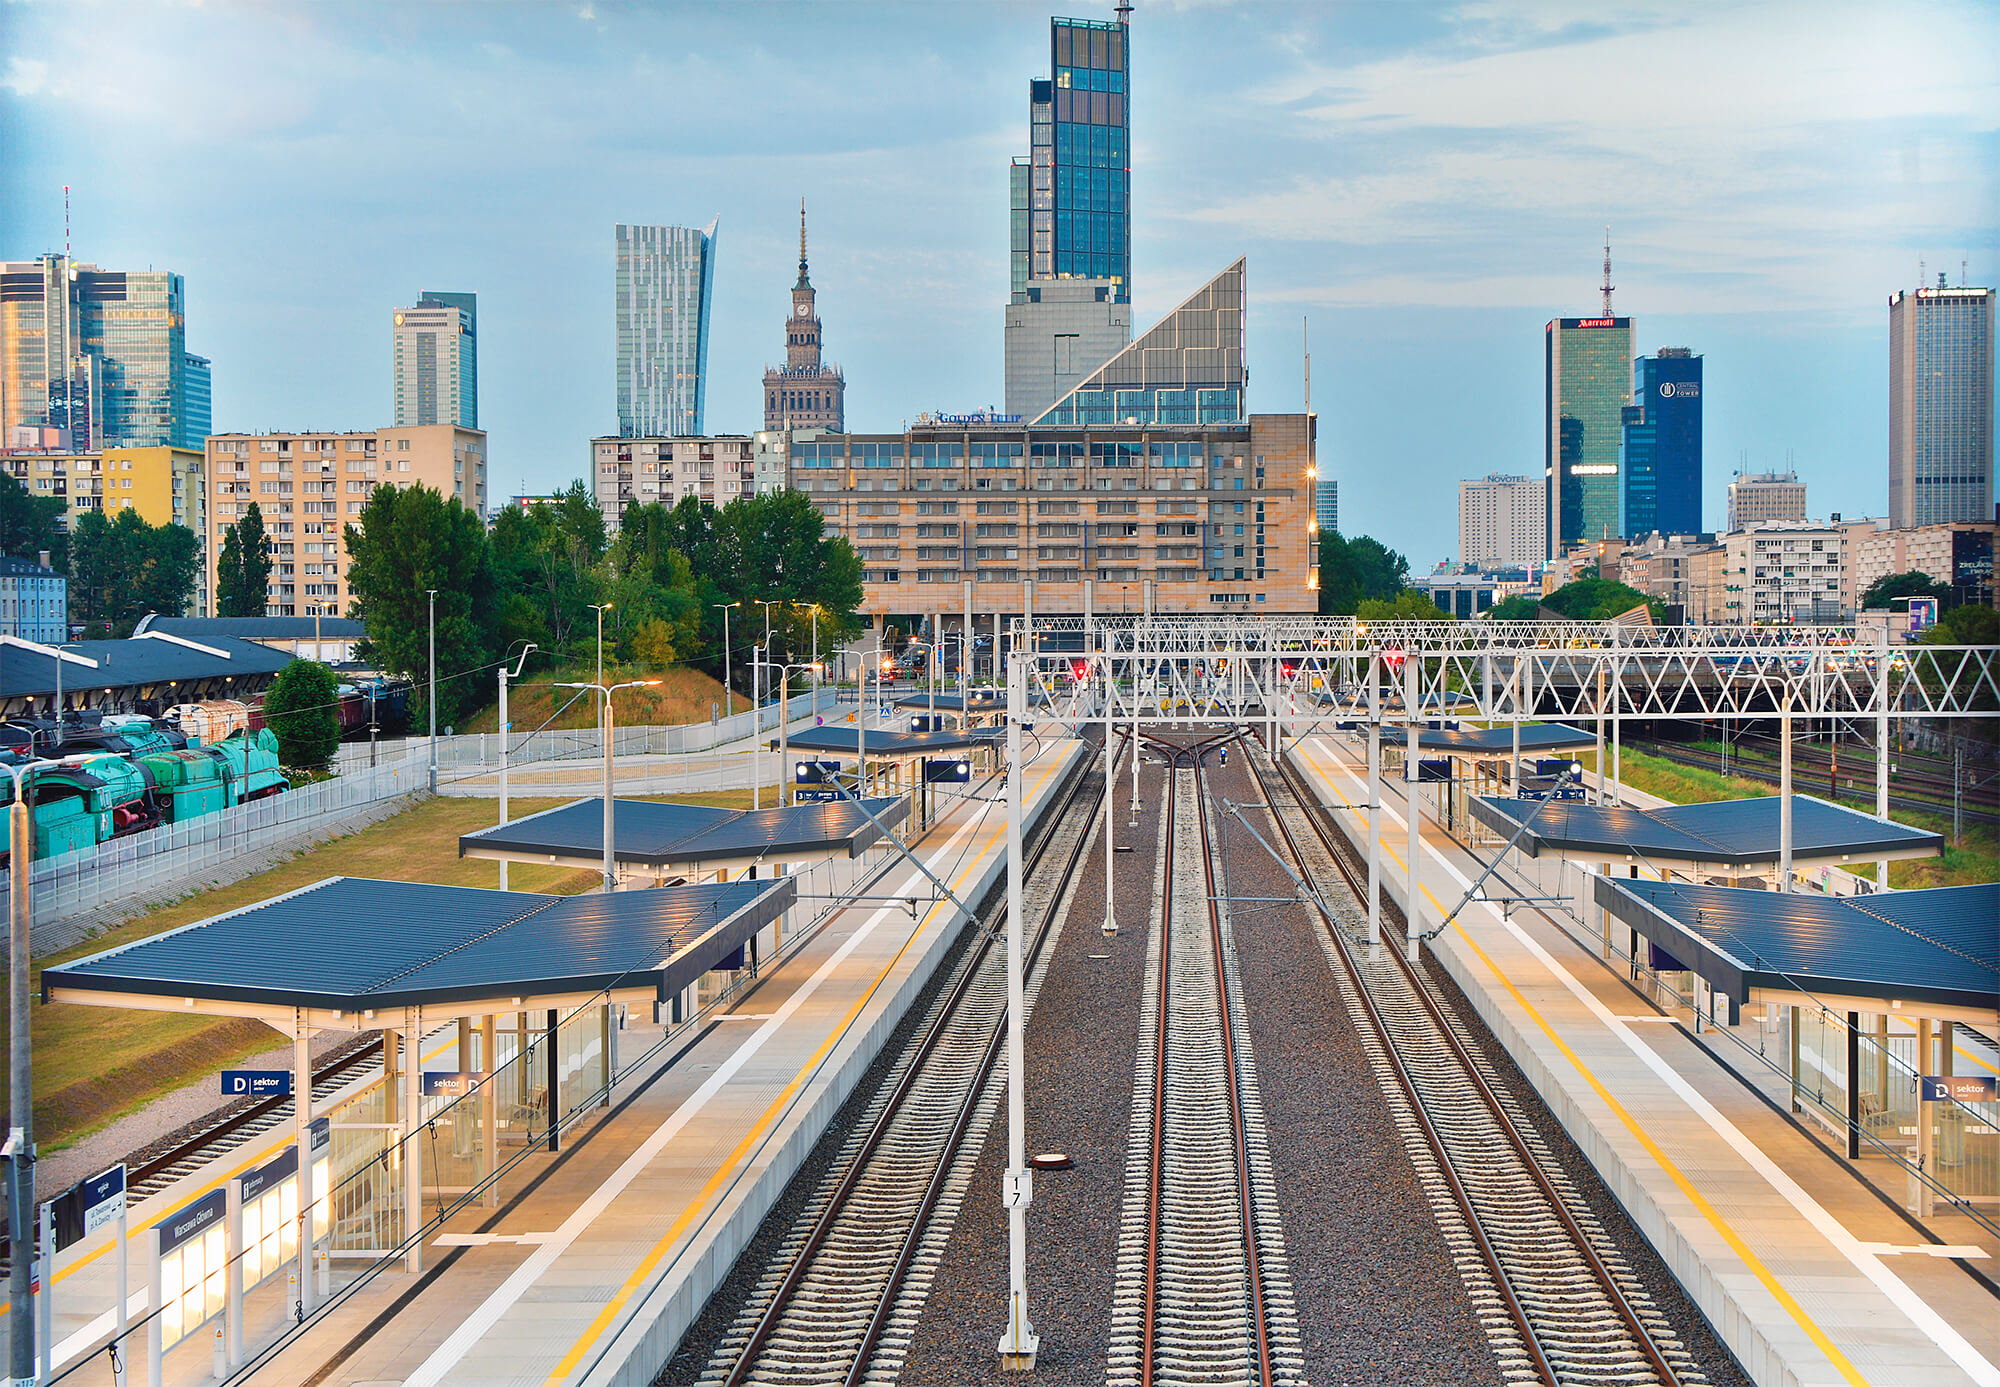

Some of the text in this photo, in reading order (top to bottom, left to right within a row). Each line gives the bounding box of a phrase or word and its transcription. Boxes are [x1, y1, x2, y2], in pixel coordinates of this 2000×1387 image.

[1578, 319, 1614, 328] Marriott
[939, 412, 1021, 424] GOLDEN TULIP
[1487, 475, 1527, 483] NOVOTEL
[234, 1077, 280, 1092] D sektor
[433, 1079, 460, 1088] sektor
[467, 1079, 480, 1094] D
[1935, 1083, 1949, 1098] D
[1956, 1084, 1985, 1093] sektor
[1014, 1176, 1018, 1190] 1
[1012, 1192, 1021, 1206] 7
[174, 1217, 197, 1239] Warszawa
